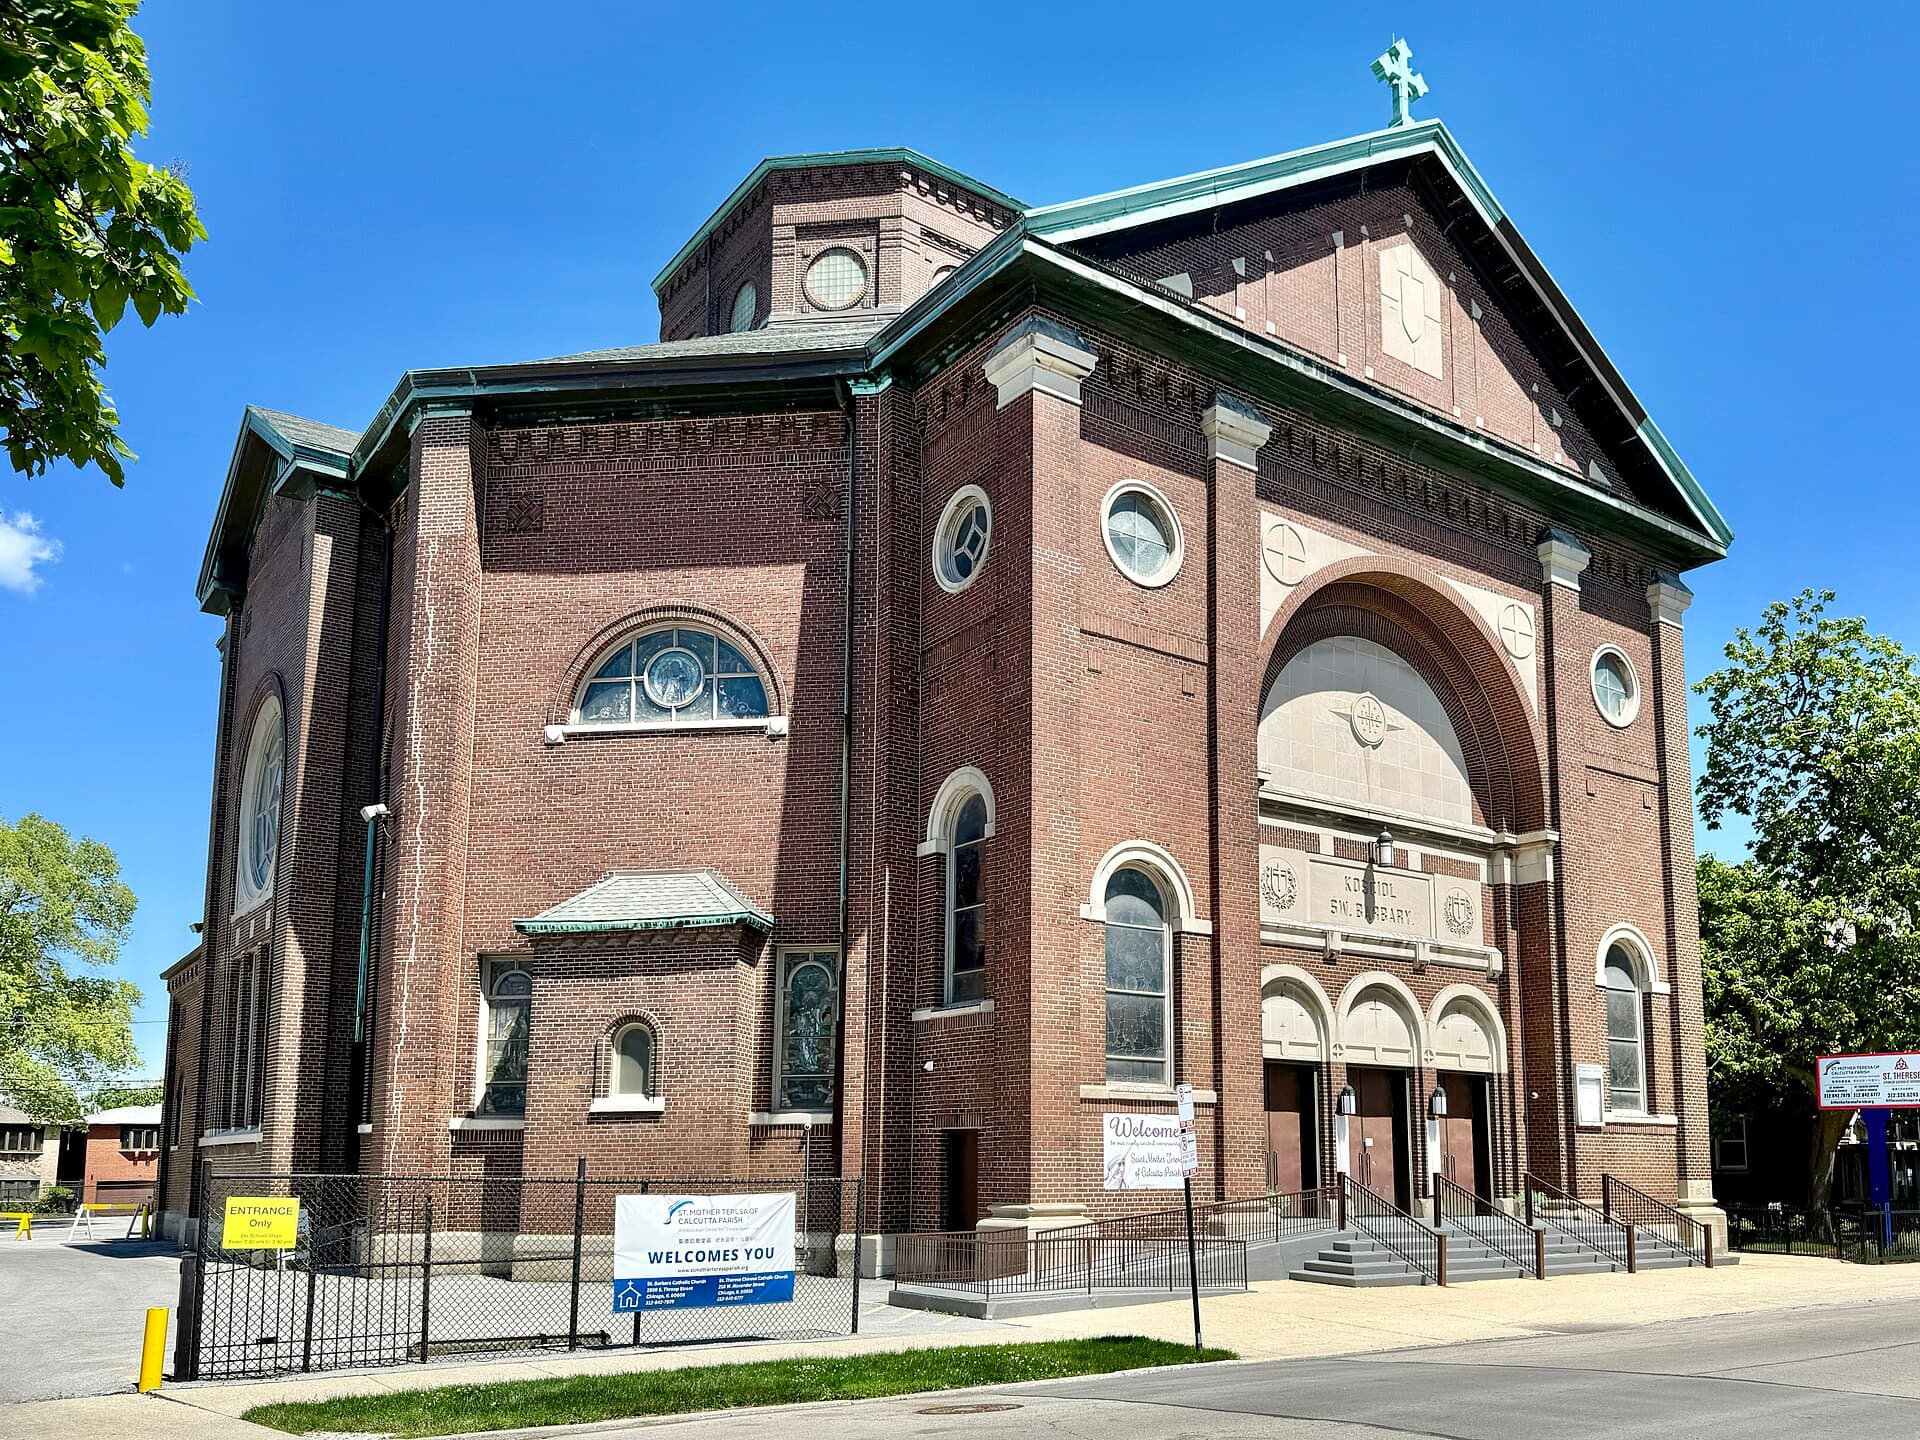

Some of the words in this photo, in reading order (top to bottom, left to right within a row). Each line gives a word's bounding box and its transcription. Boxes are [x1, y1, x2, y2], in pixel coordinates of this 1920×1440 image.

[1355, 902, 1415, 926] BRBARY.
[1109, 1116, 1180, 1138] Welcome
[230, 1206, 293, 1215] ENTRANCE
[690, 1208, 721, 1216] MOTHER
[249, 1219, 272, 1229] Only
[678, 1217, 717, 1225] CALCUTTA
[648, 1250, 739, 1265] WELCOMES
[744, 1247, 774, 1260] YOU
